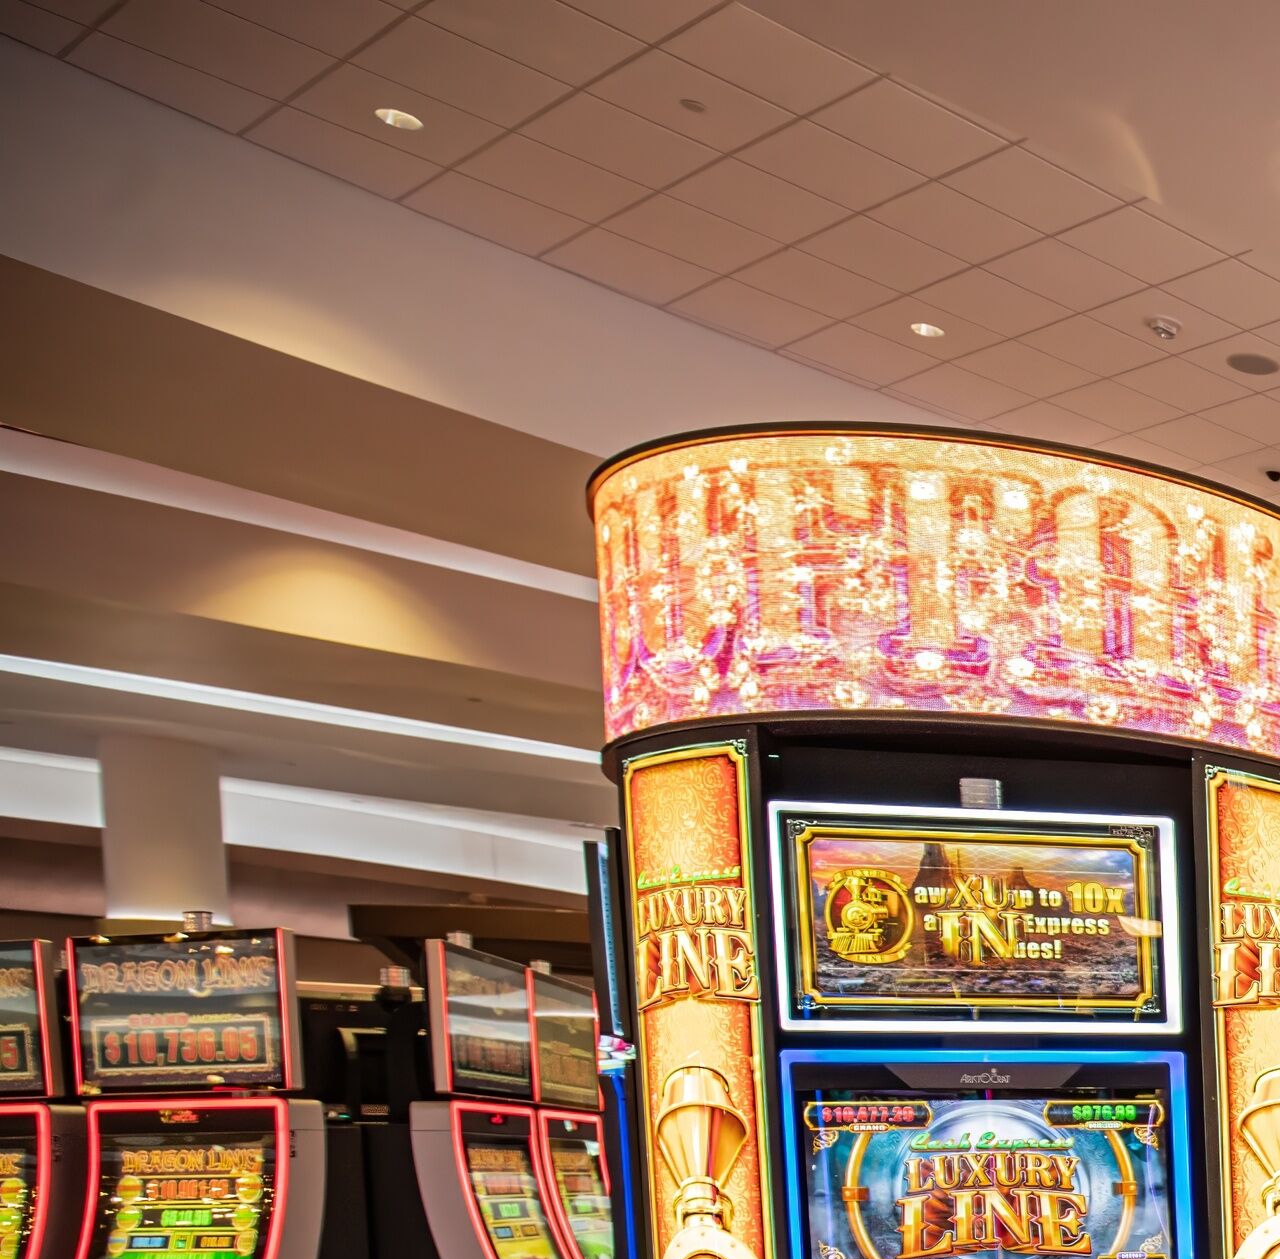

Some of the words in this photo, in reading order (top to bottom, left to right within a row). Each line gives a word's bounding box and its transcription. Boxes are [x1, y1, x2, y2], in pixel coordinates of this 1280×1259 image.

[637, 886, 747, 938] LUXURY
[1040, 887, 1063, 907] to
[1066, 881, 1126, 914] 10x
[1023, 913, 1110, 936] Express
[82, 960, 197, 993] DRAGON
[202, 956, 274, 988] LINK
[636, 927, 761, 1010] LINE
[122, 1150, 204, 1173] DRAGON
[903, 1151, 1082, 1194] LUXURY
